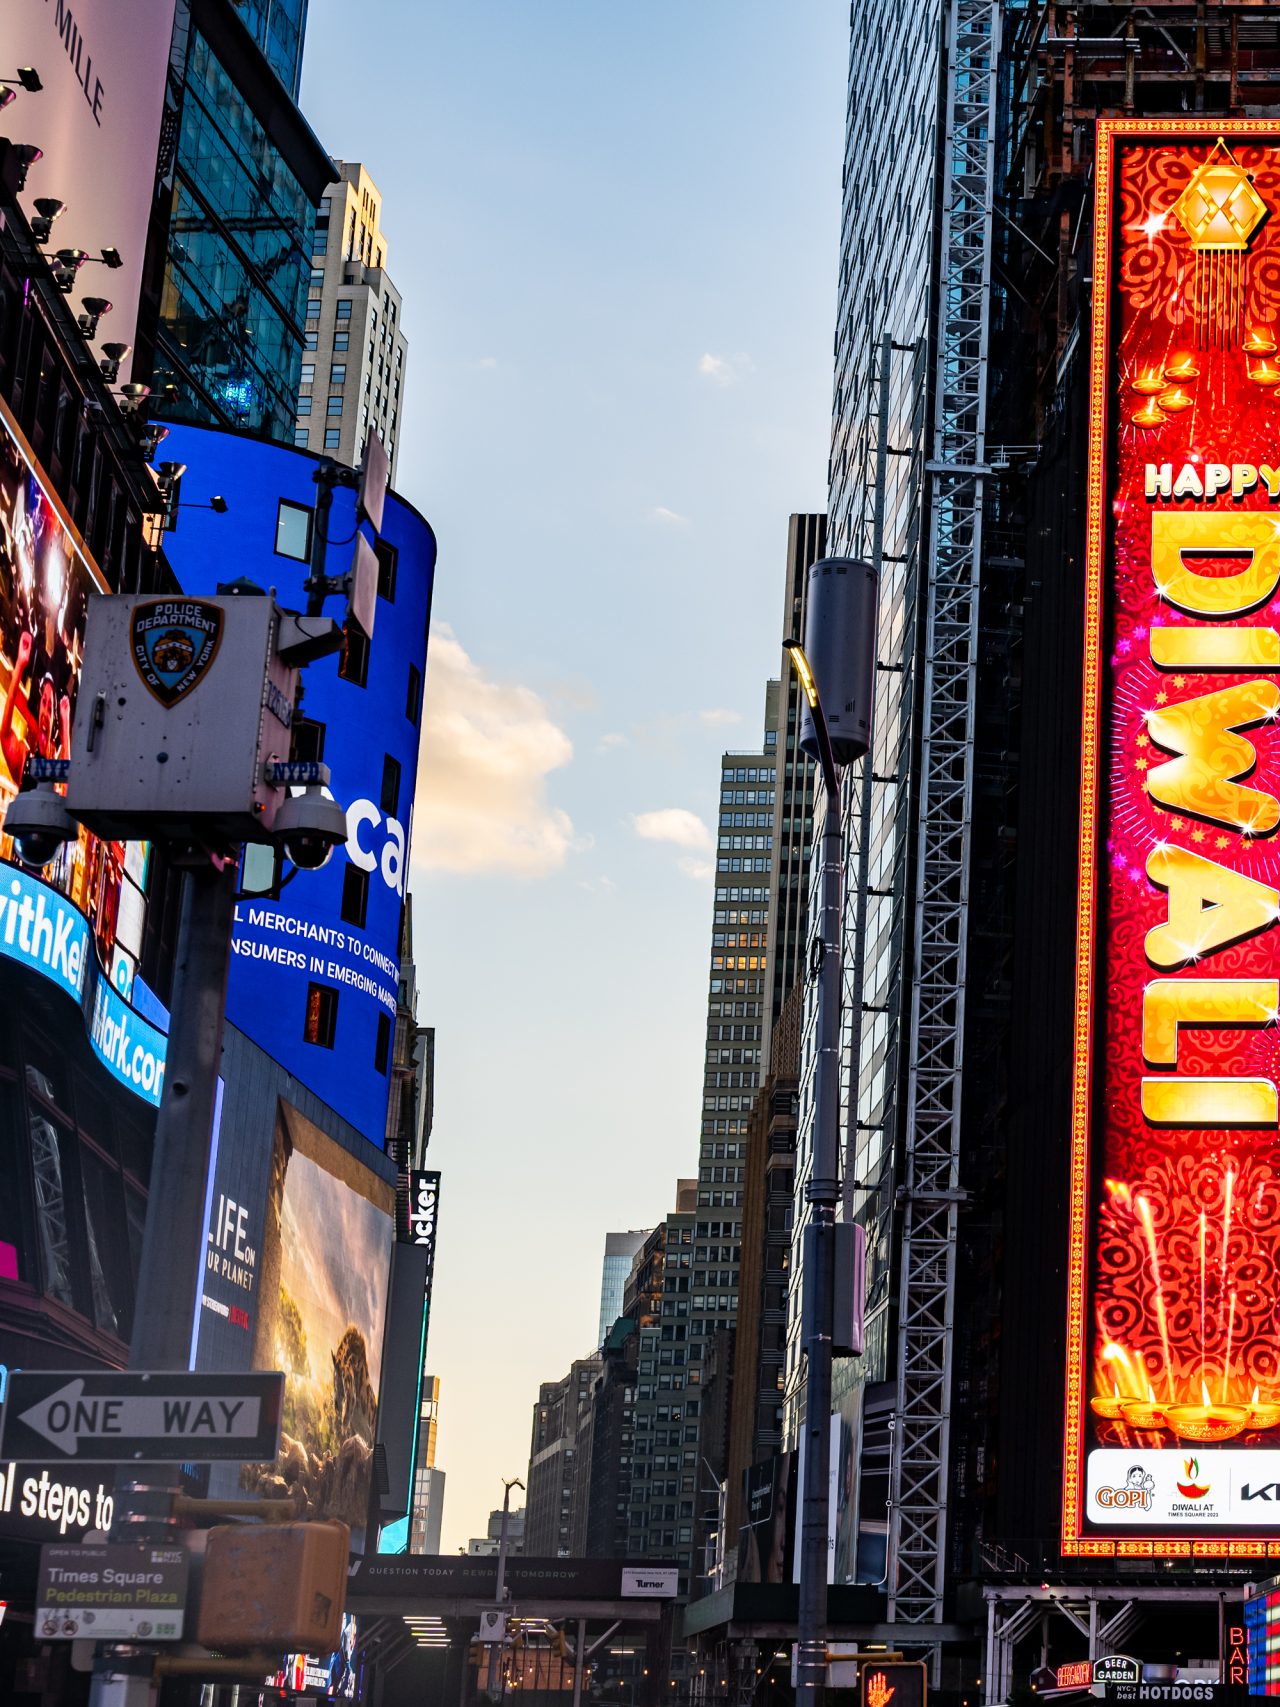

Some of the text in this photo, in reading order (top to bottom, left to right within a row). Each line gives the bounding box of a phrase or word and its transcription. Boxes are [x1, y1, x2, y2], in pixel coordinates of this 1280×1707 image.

[55, 0, 104, 128] MILLE
[155, 604, 202, 617] POLICE
[137, 615, 216, 633] DEPARTMENT
[136, 640, 215, 692] CITY OF NEW YORK
[272, 762, 320, 780] NYPD
[249, 908, 345, 949] MERCHANTS
[347, 936, 362, 956] TO
[363, 944, 395, 979] CONNECT
[310, 956, 324, 975] IN
[327, 961, 377, 998] EMERGING
[208, 1194, 256, 1267] IFE ON
[221, 1258, 253, 1291] PLANET
[47, 1400, 244, 1434] ONE WAY
[20, 1471, 90, 1534] steps
[96, 1484, 113, 1531] to
[1095, 1486, 1151, 1509] GOPI
[48, 1567, 163, 1586] Times Square
[369, 1567, 577, 1579] QUESTION TODAY REWRIE TOMORROW
[635, 1580, 665, 1589] Turner
[46, 1588, 178, 1604] Pedestrian Plaza
[1105, 1659, 1127, 1669] BEER
[1229, 1627, 1245, 1684] BAR
[1098, 1671, 1134, 1680] GARDEN
[1117, 1692, 1136, 1700] best
[1140, 1686, 1214, 1700] HOTDOGS
